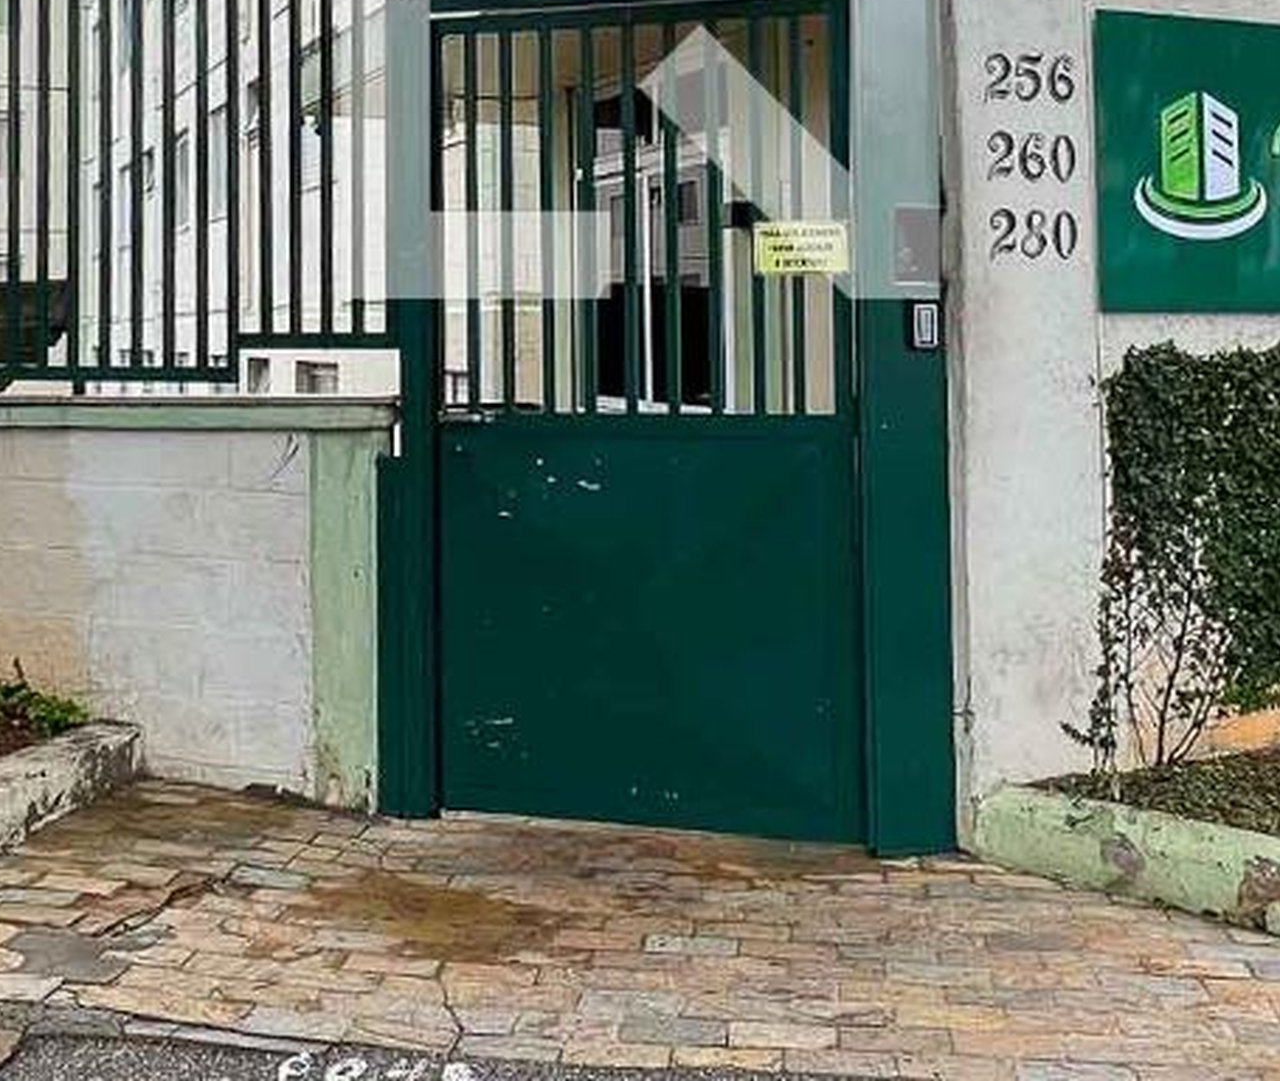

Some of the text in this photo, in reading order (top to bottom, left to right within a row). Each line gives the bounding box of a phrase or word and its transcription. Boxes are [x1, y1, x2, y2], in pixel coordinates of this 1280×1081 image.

[984, 52, 1075, 104] 256
[987, 130, 1076, 183] 260
[989, 207, 1078, 262] 280
